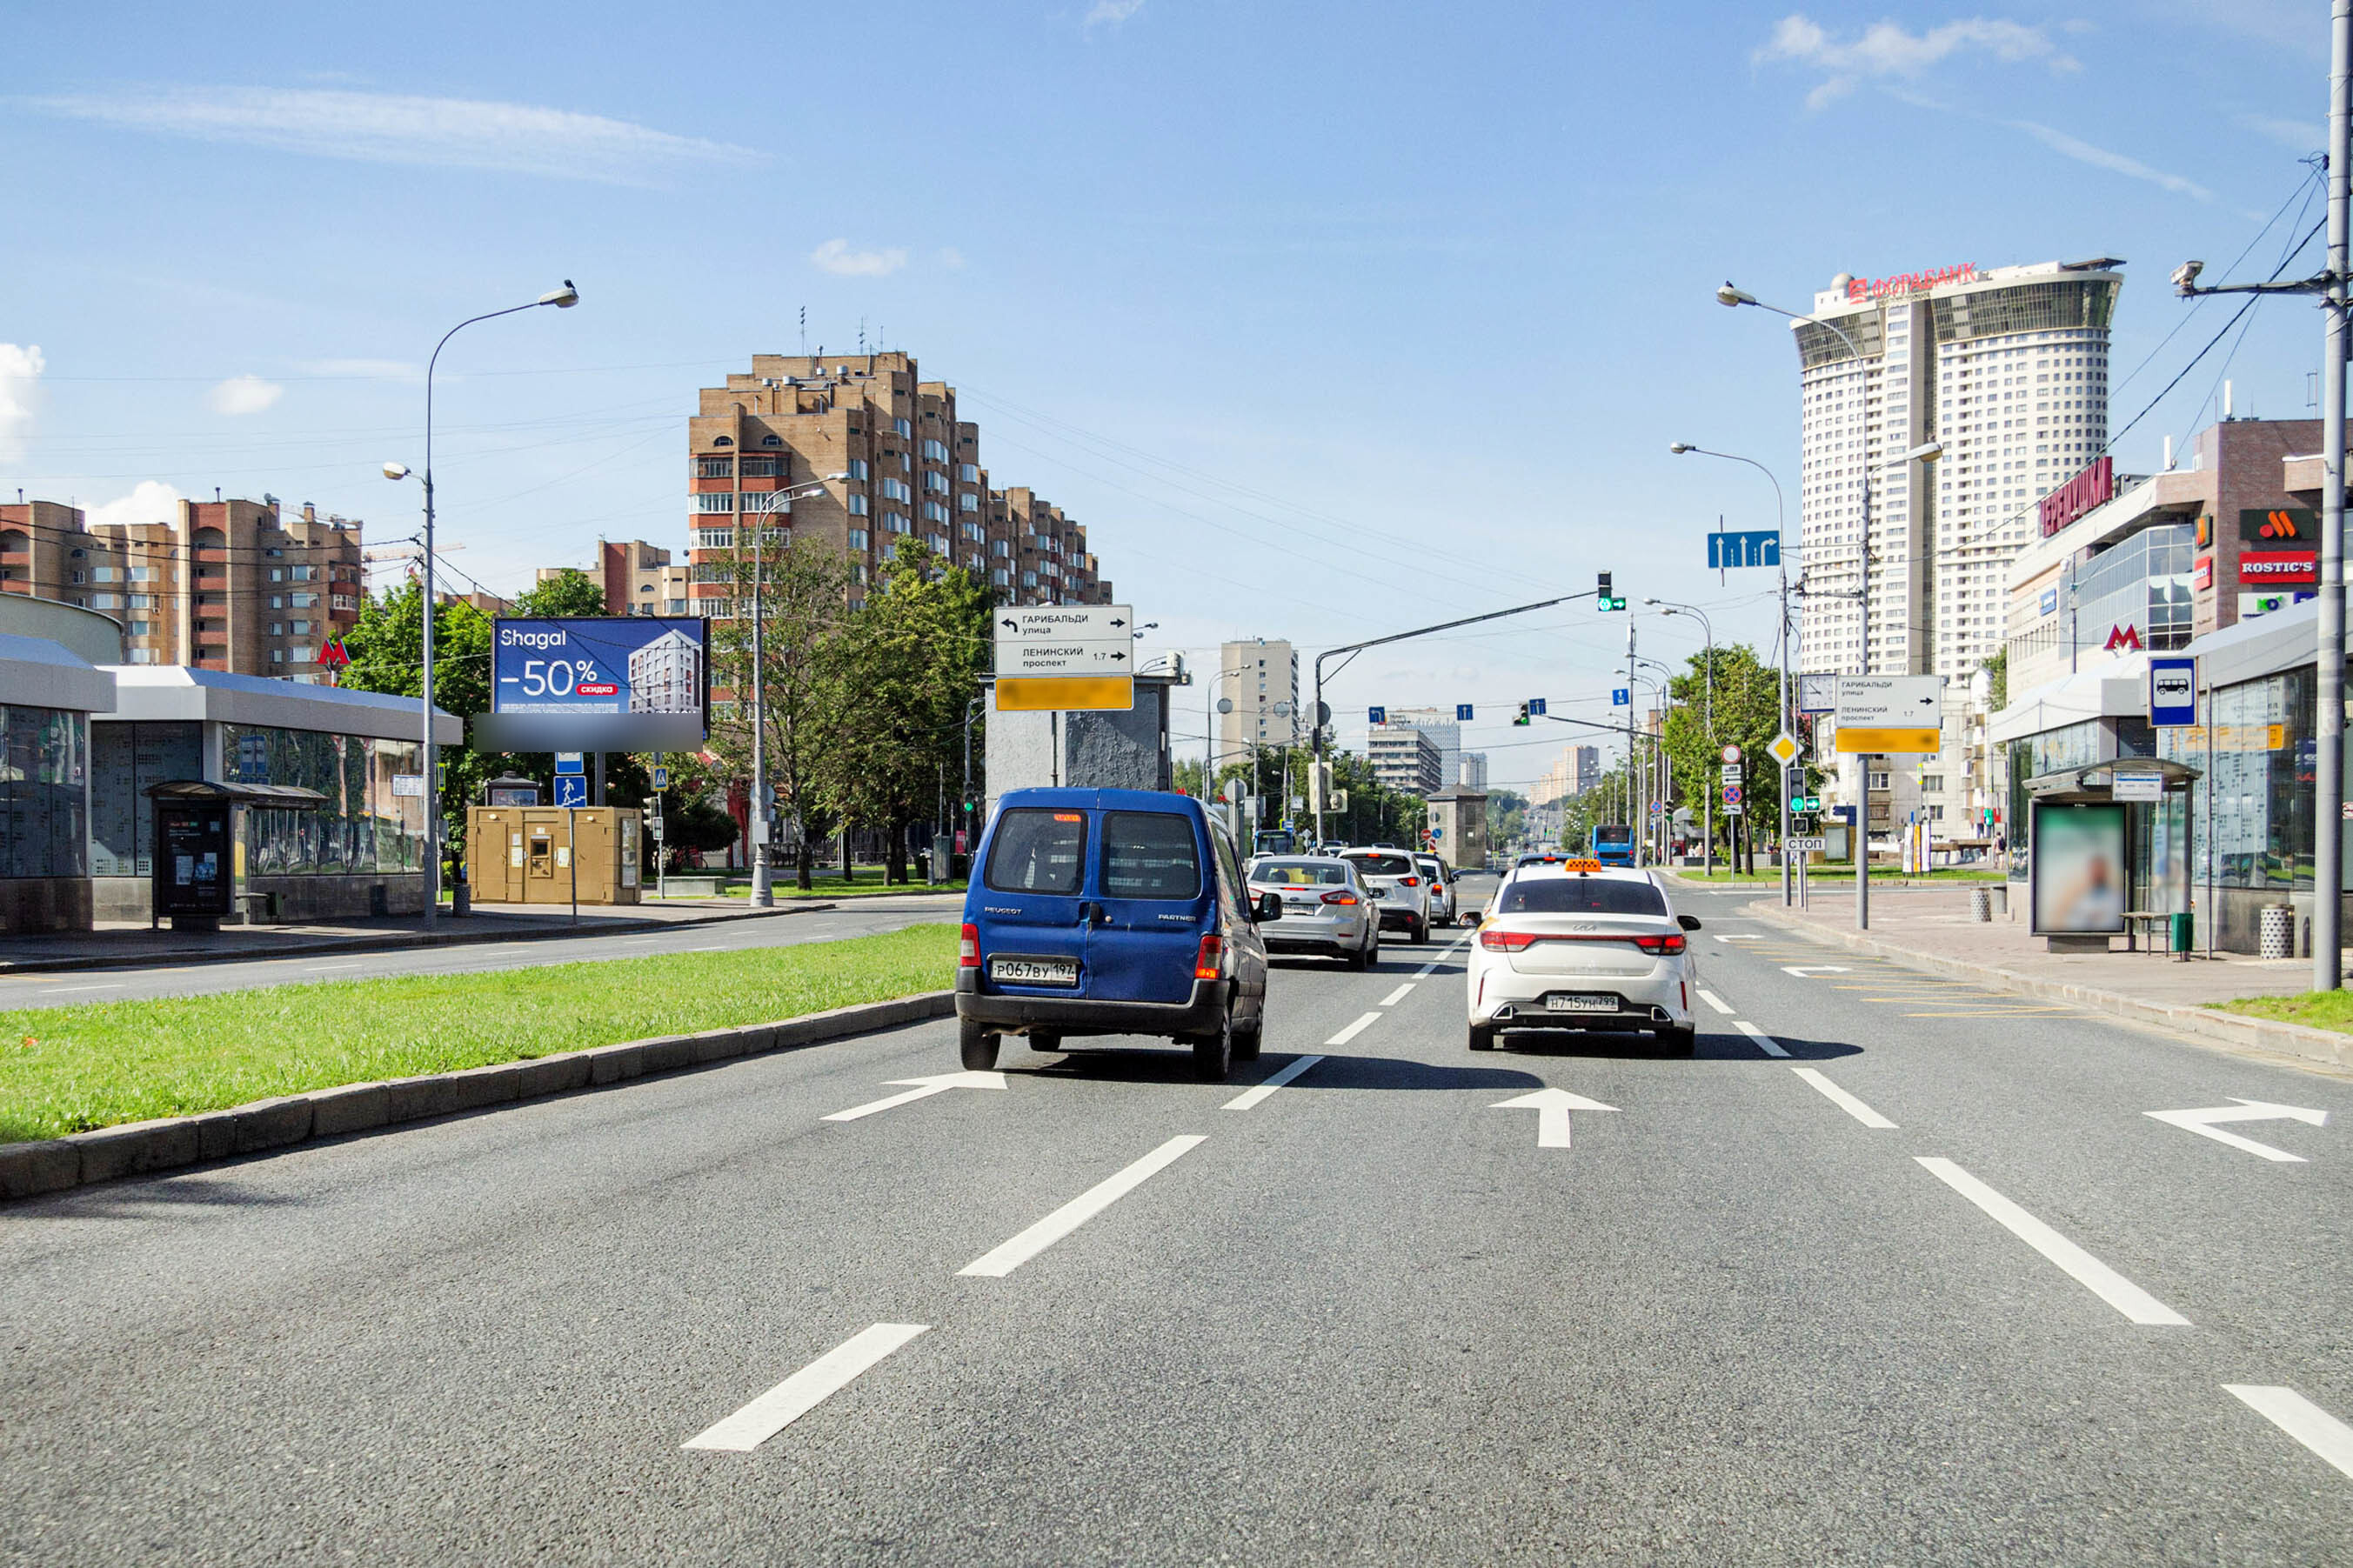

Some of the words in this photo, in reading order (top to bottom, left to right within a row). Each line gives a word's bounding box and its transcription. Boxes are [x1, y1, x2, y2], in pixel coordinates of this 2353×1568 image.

[1872, 262, 1975, 298] ФОРАБАНК
[2242, 562, 2313, 573] ROSTIC'S
[1022, 615, 1089, 624] ГАРИБАЛЬДИ
[1022, 627, 1052, 636] улица
[500, 630, 566, 650] Shagal
[1022, 647, 1084, 657] ЛЕНИНСКИЙ
[1023, 659, 1067, 668] проспект
[1788, 839, 1822, 849] СТОП
[985, 906, 1022, 915] PEUGEOT
[1053, 964, 1073, 975] 197
